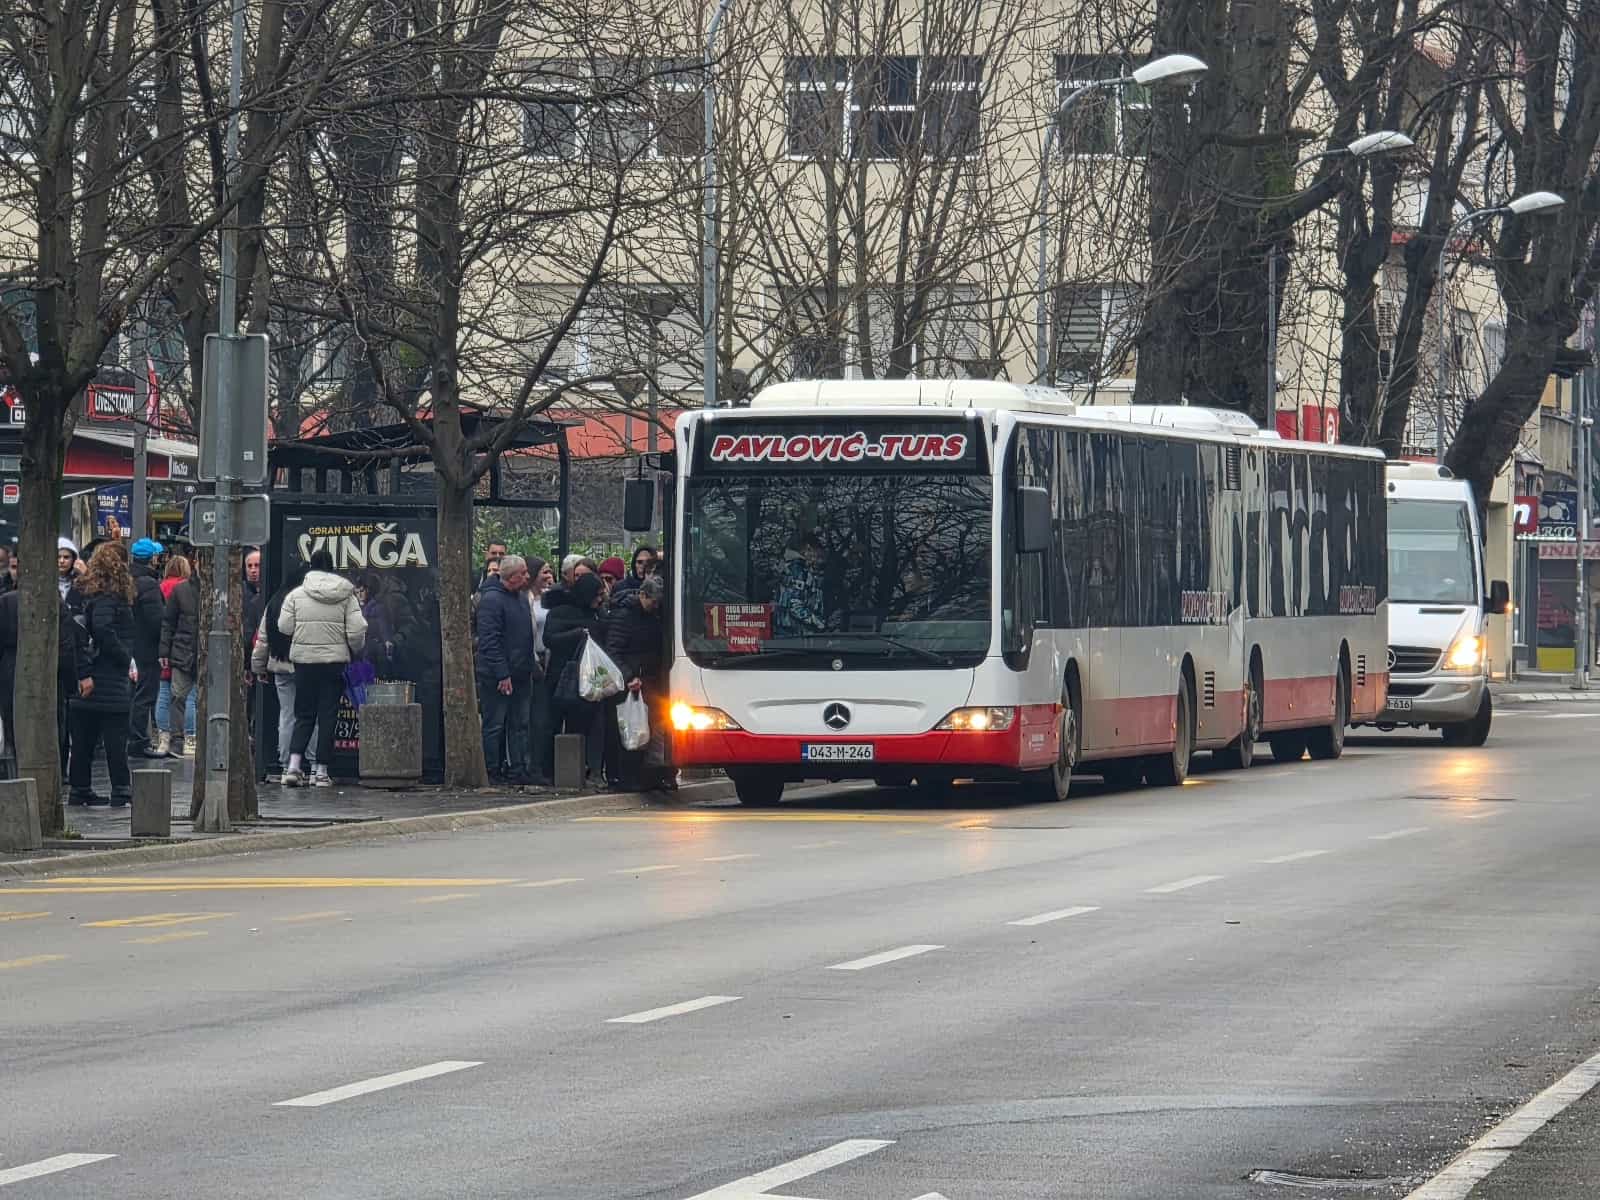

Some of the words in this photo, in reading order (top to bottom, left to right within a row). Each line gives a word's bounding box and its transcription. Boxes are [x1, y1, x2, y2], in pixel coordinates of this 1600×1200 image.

[711, 432, 967, 461] PAVLOVIĆ-TURS
[308, 526, 341, 536] GORAN
[297, 522, 429, 569] VINČA
[809, 745, 872, 759] 043-M-246
